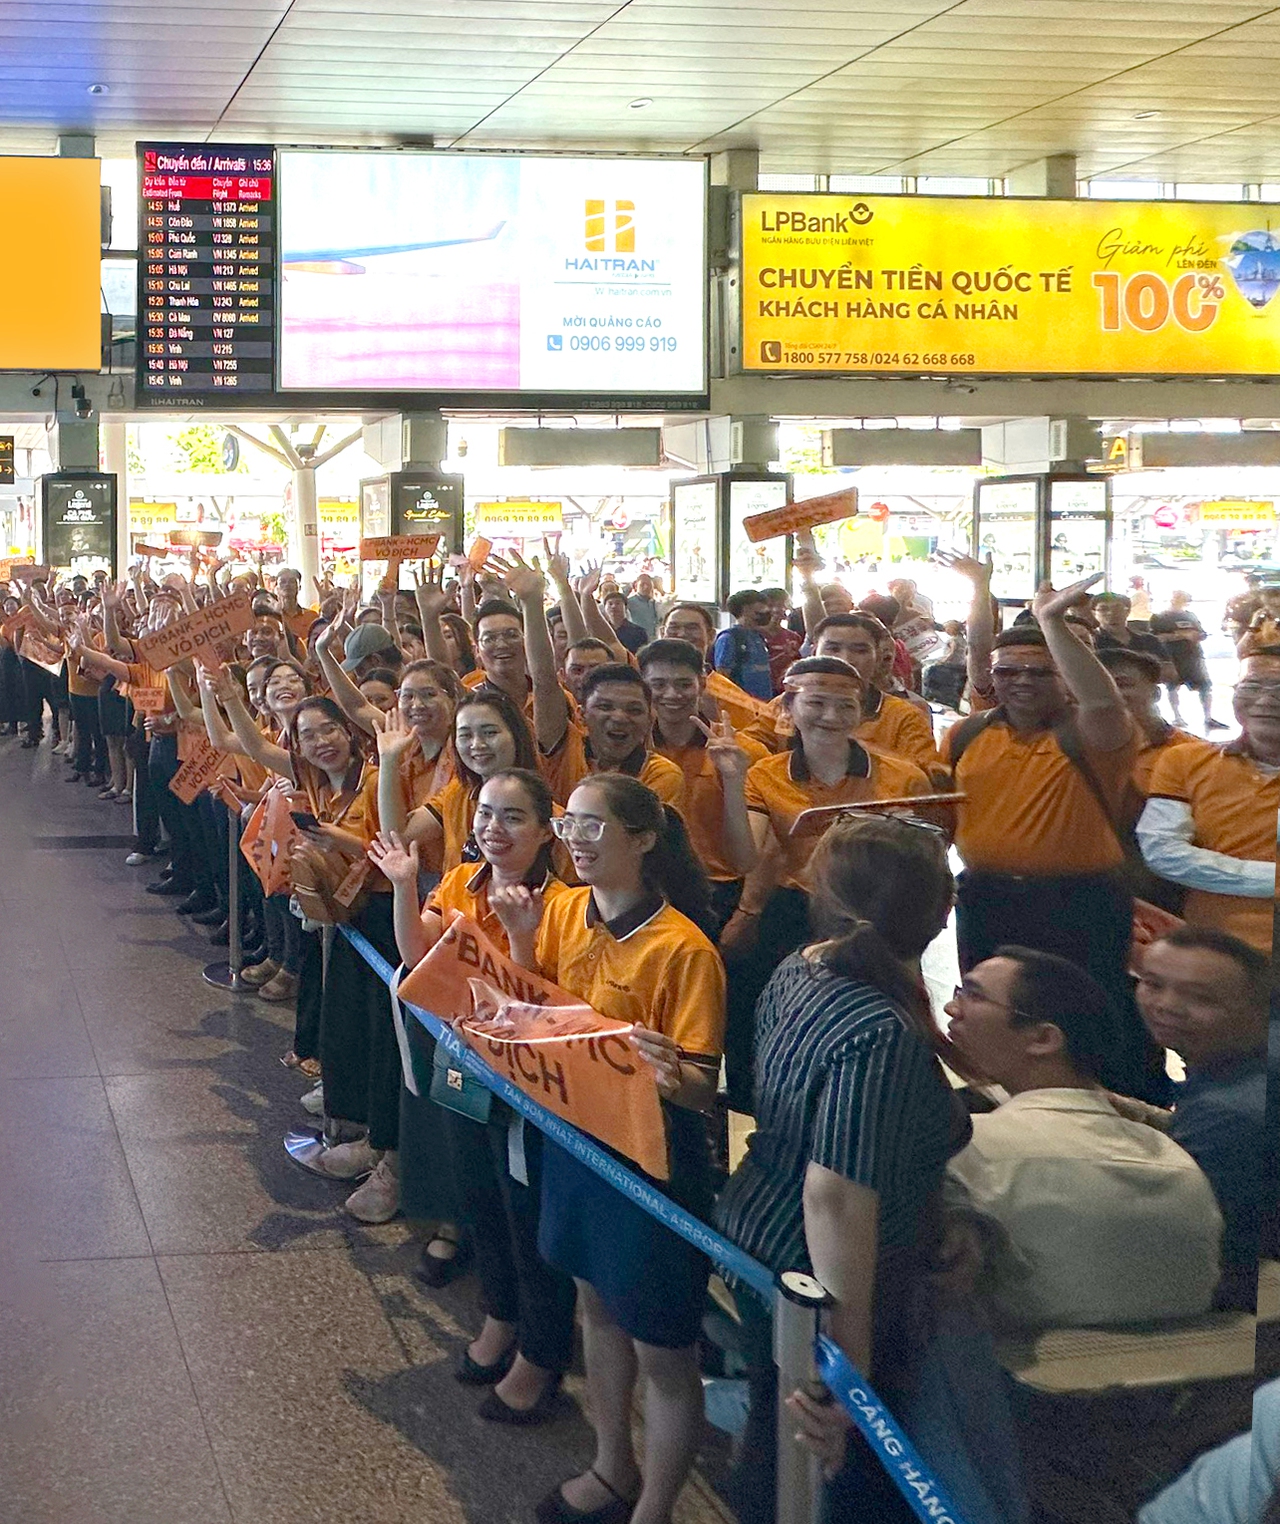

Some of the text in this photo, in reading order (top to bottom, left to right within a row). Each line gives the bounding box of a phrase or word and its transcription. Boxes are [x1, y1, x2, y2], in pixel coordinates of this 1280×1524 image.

[157, 155, 272, 172] Chuyến đến Arrivals 15:36
[168, 189, 182, 198] From
[212, 189, 261, 199] Flight Remarks
[238, 203, 258, 212] Arrived
[238, 218, 258, 227] Arrived
[761, 211, 849, 233] LPBank
[238, 234, 258, 243] Arrived
[238, 250, 258, 260] Arrived
[1096, 228, 1210, 270] Giảm phí
[565, 258, 655, 271] HAITRAN
[1176, 259, 1195, 268] LÊN
[238, 266, 258, 275] Arrived
[758, 261, 1074, 296] CHUYỂN TIỀN QUỐC TẾ
[238, 282, 258, 291] Arrived
[238, 298, 258, 307] Arrived
[759, 296, 1018, 320] KHÁCH HÀNG CÁ NHÂN
[238, 313, 258, 322] Arrived
[563, 315, 662, 328] MỜI QUẢNG CÁO
[570, 335, 677, 352] 0906 999 919
[783, 352, 814, 363] 1800
[818, 352, 841, 363] 577
[844, 352, 868, 364] 758
[903, 353, 919, 365] 62
[922, 353, 947, 365] 668
[950, 353, 975, 365] 668
[144, 598, 244, 651] LPBANK HCMC
[168, 621, 231, 657] VÔ ĐỊCH
[438, 1024, 461, 1058] TIA
[504, 1084, 521, 1103] TAN
[523, 1102, 546, 1122] SON
[574, 1142, 668, 1219] INTERNATIONAL
